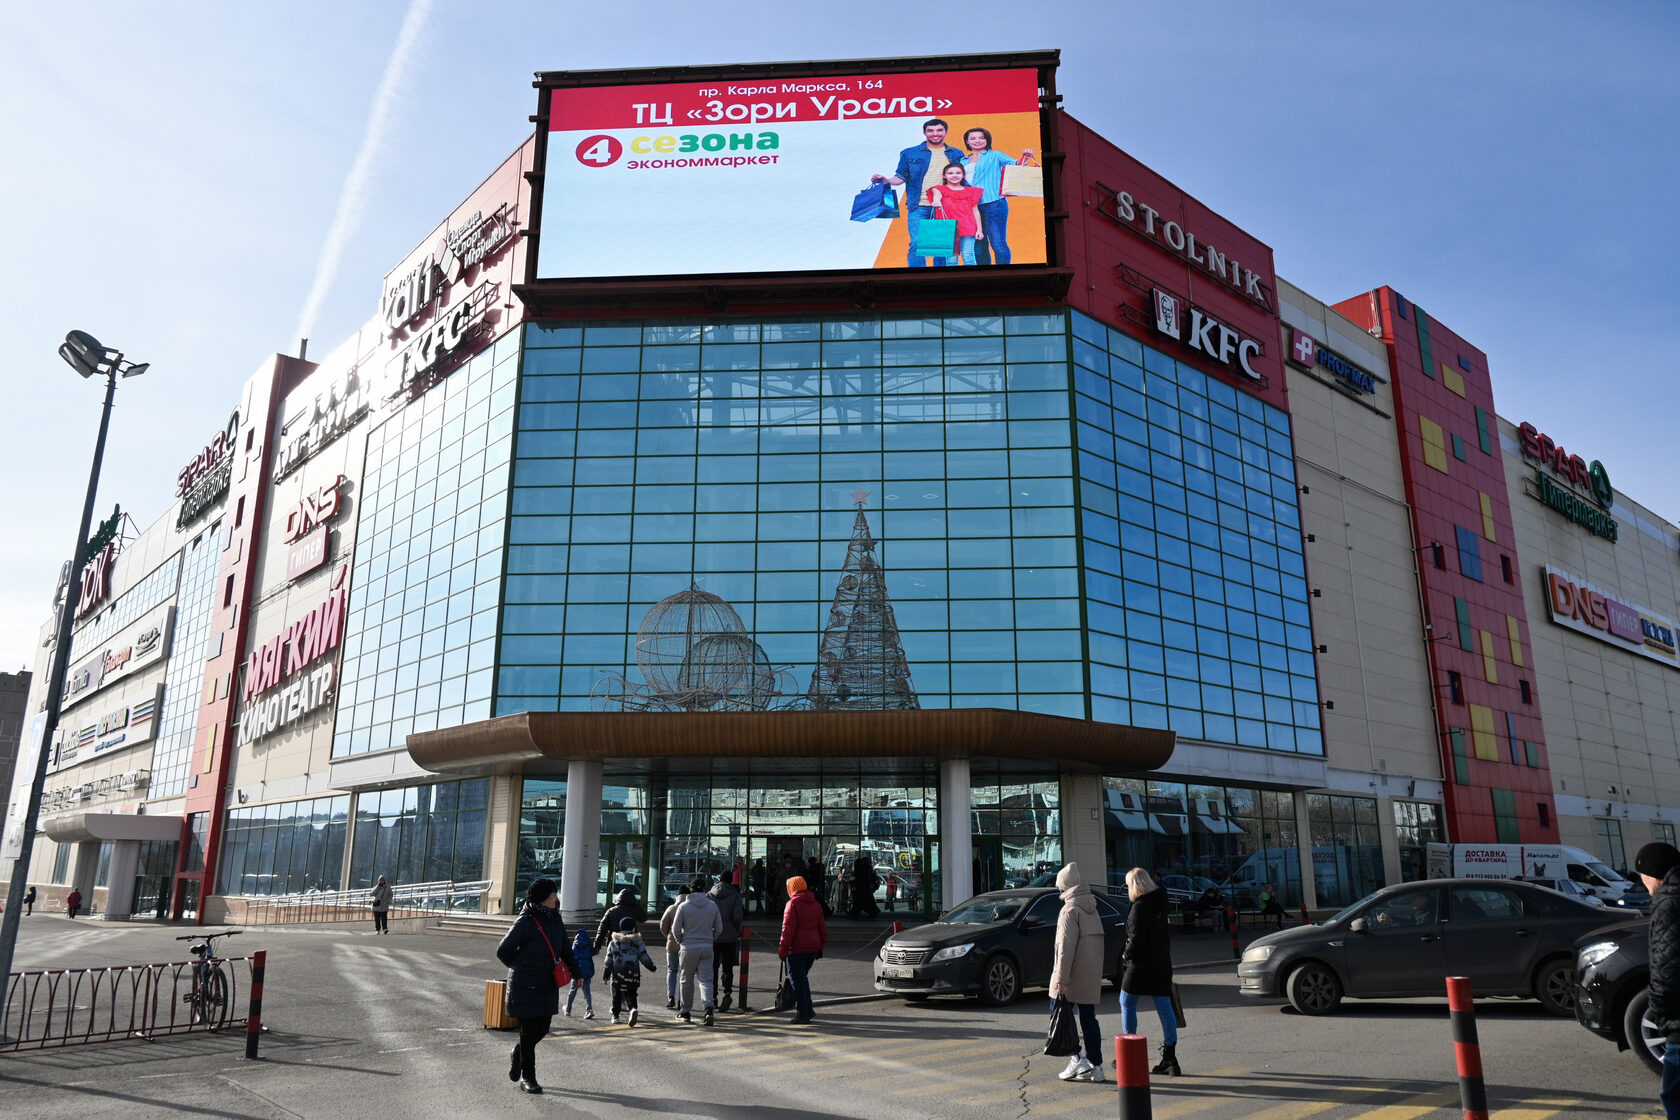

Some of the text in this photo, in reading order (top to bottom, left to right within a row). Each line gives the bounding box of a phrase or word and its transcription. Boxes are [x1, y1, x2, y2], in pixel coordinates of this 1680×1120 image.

[632, 94, 953, 126] ТЦ «Зори Урала»
[700, 79, 883, 97] пр. Карла Маркса, 164
[583, 130, 779, 164] 4 сезона
[627, 153, 779, 170] экономмаркет
[1116, 190, 1264, 300] STOLNIK
[409, 302, 471, 377] KFC
[1188, 309, 1261, 380] KFC
[175, 430, 226, 498] SPAR
[1520, 421, 1590, 489] SPAR
[284, 474, 347, 544] DNS
[1540, 471, 1618, 541] Гипермаркет
[244, 564, 347, 702] МЯГКИЙ
[1549, 573, 1609, 630] DNS
[1611, 606, 1639, 634] ГИПЕР
[237, 663, 335, 747] КИНОТЕАТР
[1465, 850, 1507, 858] ДОСТАВКА
